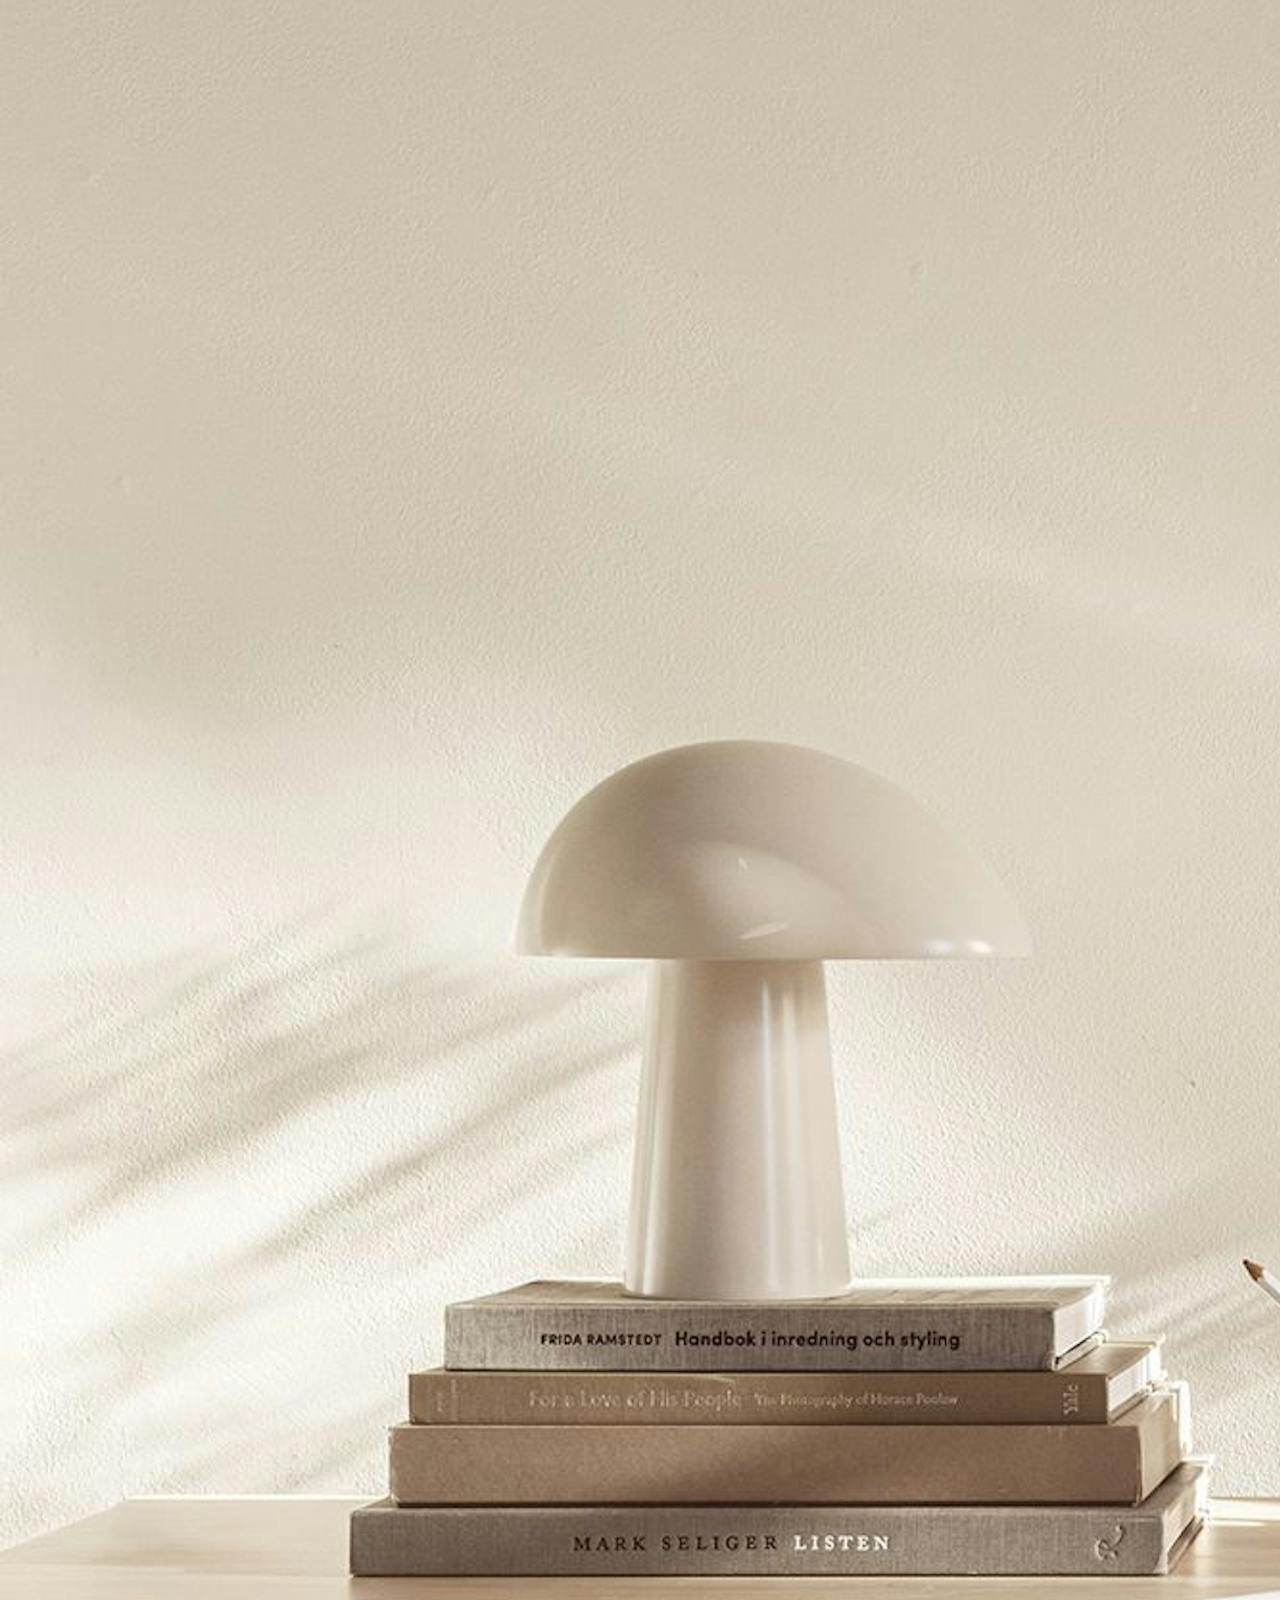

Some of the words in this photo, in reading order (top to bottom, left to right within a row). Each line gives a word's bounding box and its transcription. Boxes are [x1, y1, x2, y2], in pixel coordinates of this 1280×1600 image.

[540, 1332, 583, 1346] FRIDA
[587, 1332, 662, 1346] RAMSTEDT
[675, 1330, 757, 1347] Handbok
[760, 1330, 767, 1347] i
[771, 1330, 858, 1351] inredning
[863, 1330, 896, 1347] och
[901, 1330, 961, 1351] styling
[573, 1535, 647, 1551] MARK
[661, 1534, 779, 1551] SELIGER
[793, 1534, 890, 1551] LISTEN
